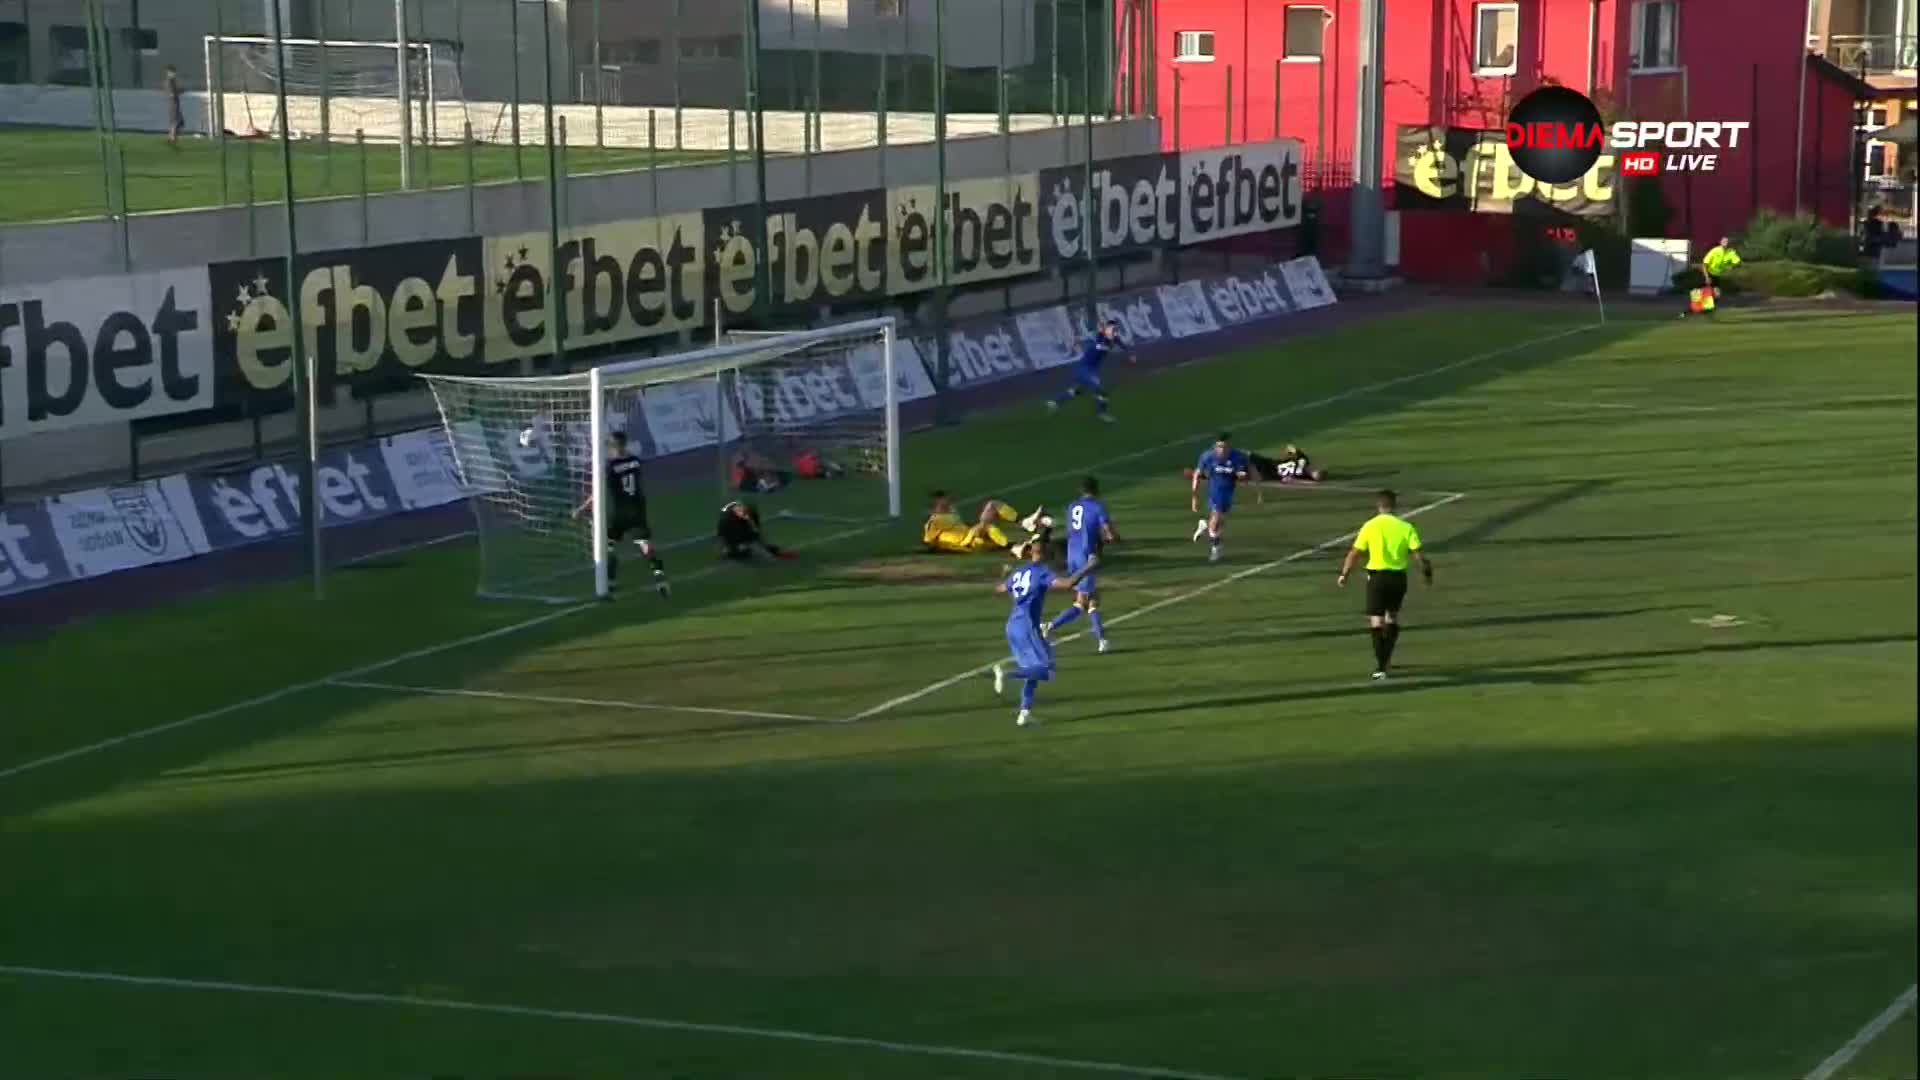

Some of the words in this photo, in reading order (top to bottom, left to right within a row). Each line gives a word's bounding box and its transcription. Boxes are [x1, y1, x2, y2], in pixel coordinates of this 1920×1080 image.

[1051, 165, 1176, 258] efbet
[1190, 152, 1298, 232] efbet
[500, 225, 696, 347] efbet
[717, 204, 883, 312] efbet
[1210, 271, 1288, 321] efbet
[232, 253, 476, 390] efbet
[621, 473, 636, 496] 4
[1071, 505, 1084, 530] 9
[1012, 569, 1032, 598] 24
